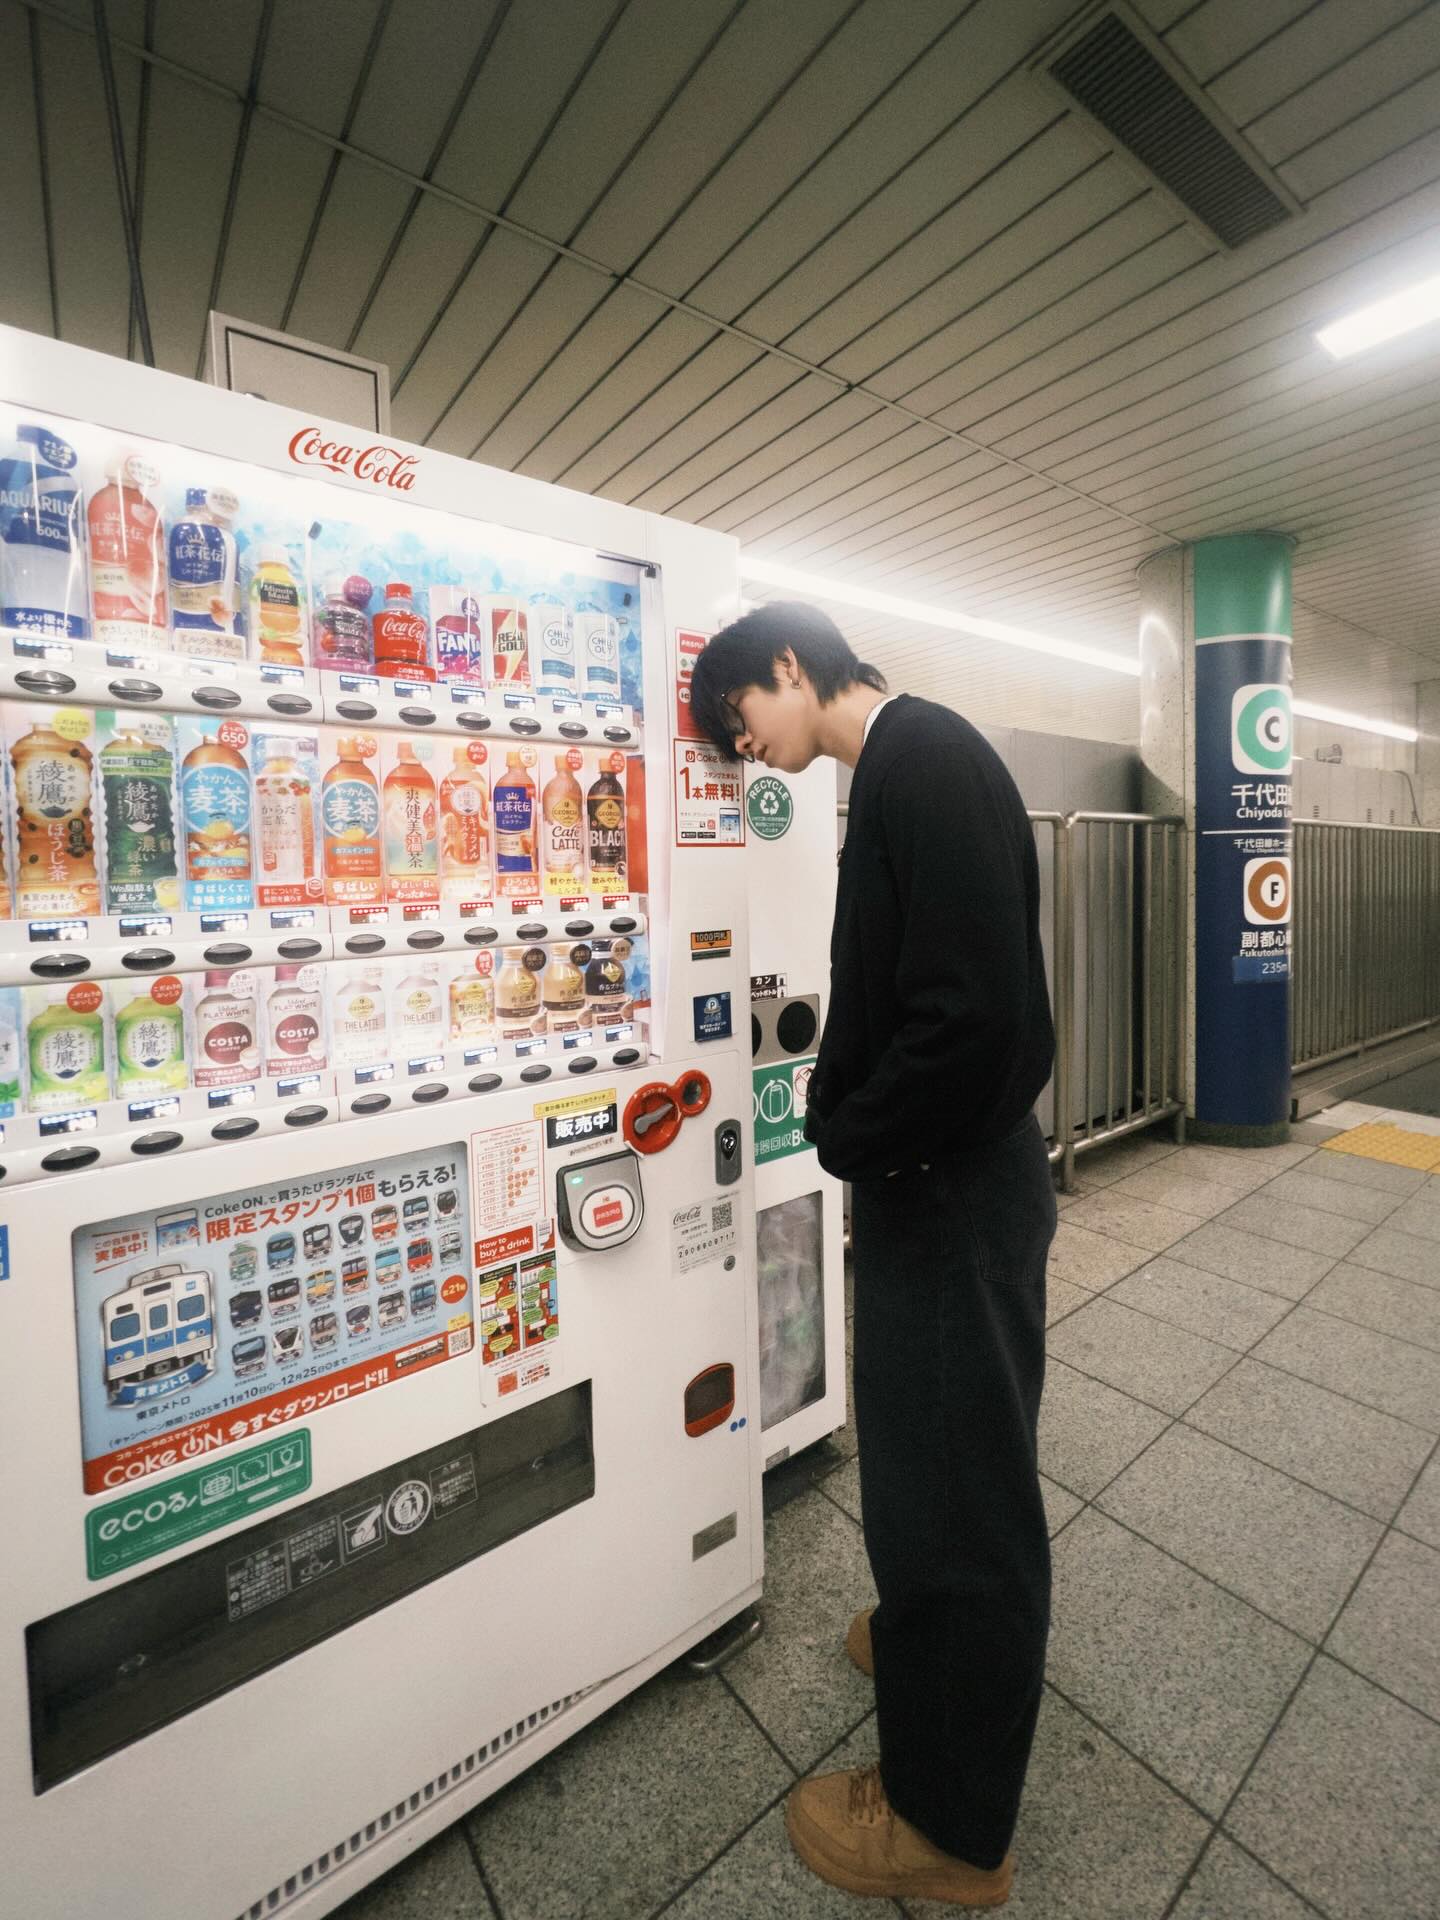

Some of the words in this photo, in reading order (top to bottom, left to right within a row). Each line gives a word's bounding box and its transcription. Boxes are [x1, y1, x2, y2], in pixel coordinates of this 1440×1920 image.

[288, 428, 421, 490] Coca-Cola
[175, 545, 225, 561] 紅茶花伝
[550, 638, 569, 649] OUT
[221, 731, 246, 744] 650
[1264, 716, 1280, 743] C
[749, 779, 790, 800] RECYCLE
[187, 786, 246, 816] 麦茶
[495, 801, 532, 813] 紅茶花伝
[326, 799, 375, 823] 麦茶
[1236, 806, 1282, 821] Chiyoda
[48, 824, 69, 881] ほうじ茶
[551, 838, 581, 851] LATTE
[1270, 881, 1280, 902] F
[755, 976, 771, 985] カン
[344, 1021, 358, 1029] THE
[359, 1018, 379, 1029] LATTE
[404, 1014, 416, 1022] THE
[416, 1011, 436, 1022] LATTE
[279, 1026, 316, 1038] COSTA
[208, 1034, 248, 1047] COSTA
[555, 1111, 610, 1140] 販売中
[204, 1202, 241, 1218] Coke
[479, 1240, 497, 1250] How
[498, 1237, 507, 1245] to
[480, 1247, 498, 1259] buy
[506, 1237, 531, 1251] drink
[136, 1395, 191, 1421] 東京メトロ
[103, 1449, 177, 1488] Coke
